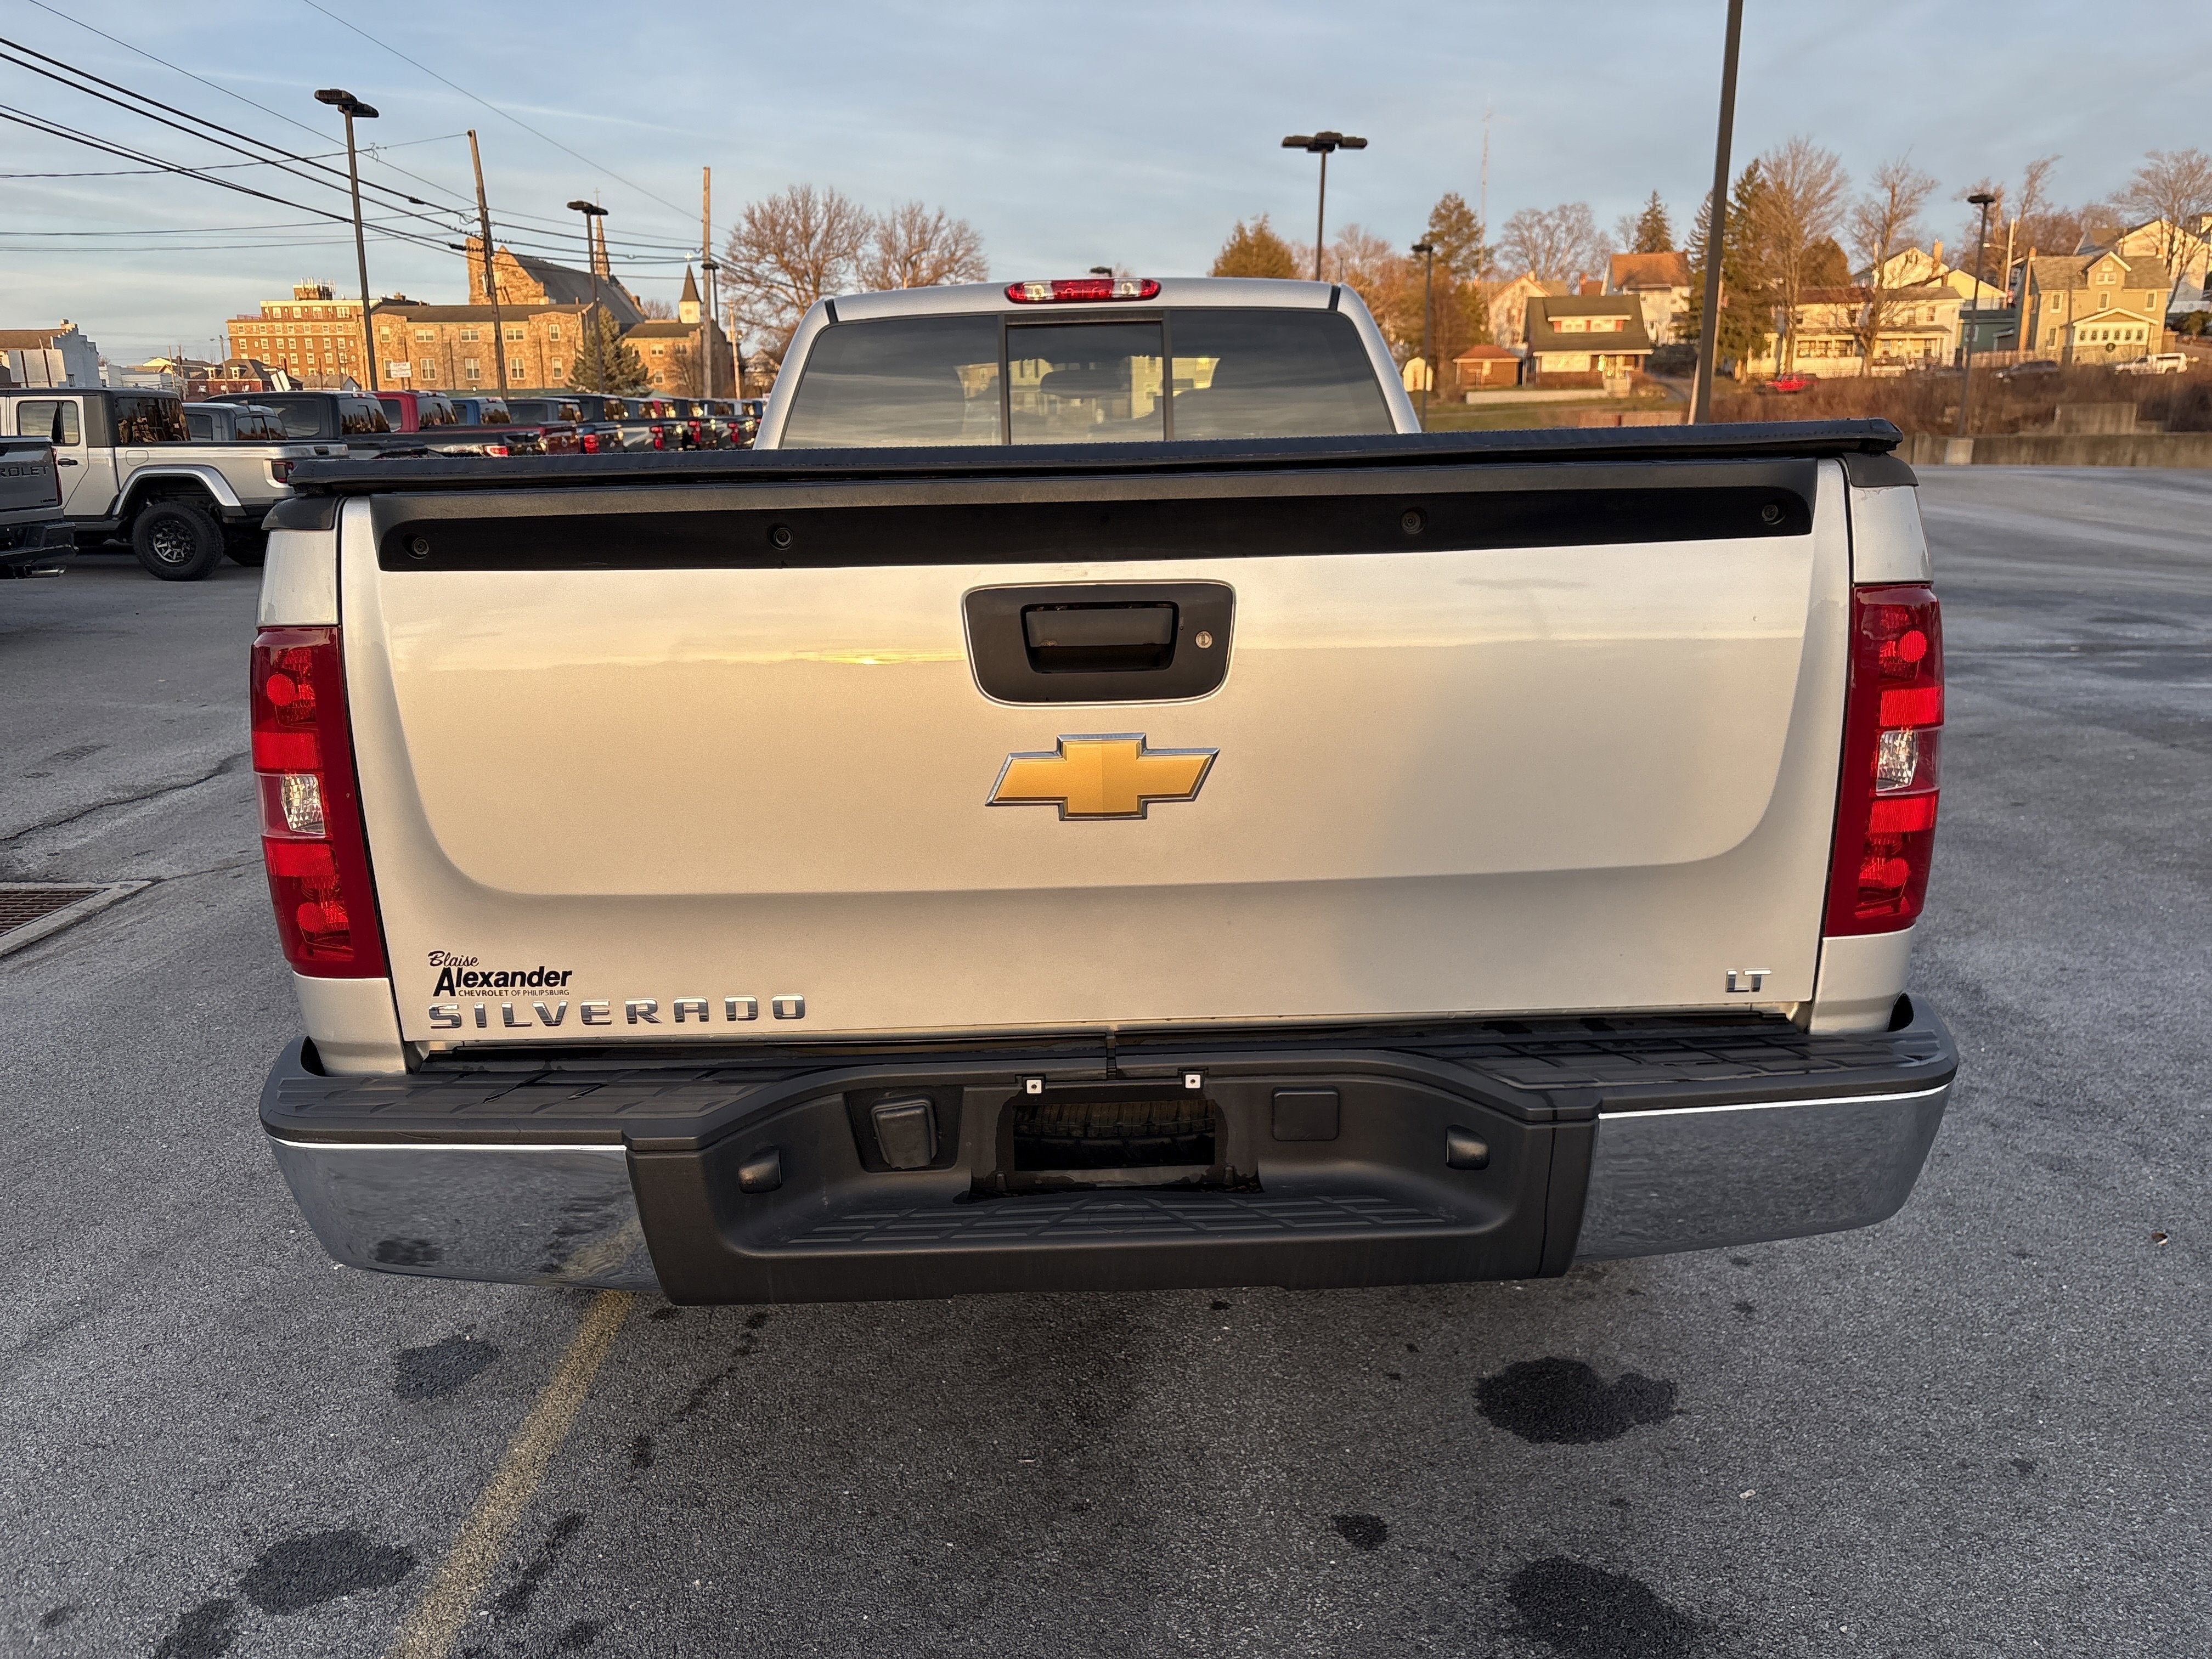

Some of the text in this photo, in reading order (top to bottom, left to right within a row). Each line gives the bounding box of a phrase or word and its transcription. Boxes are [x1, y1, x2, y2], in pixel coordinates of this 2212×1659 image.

[428, 950, 479, 967] Blaise
[432, 966, 573, 997] Alexander
[1725, 968, 1773, 993] LT
[428, 994, 806, 1029] SILVERADO
